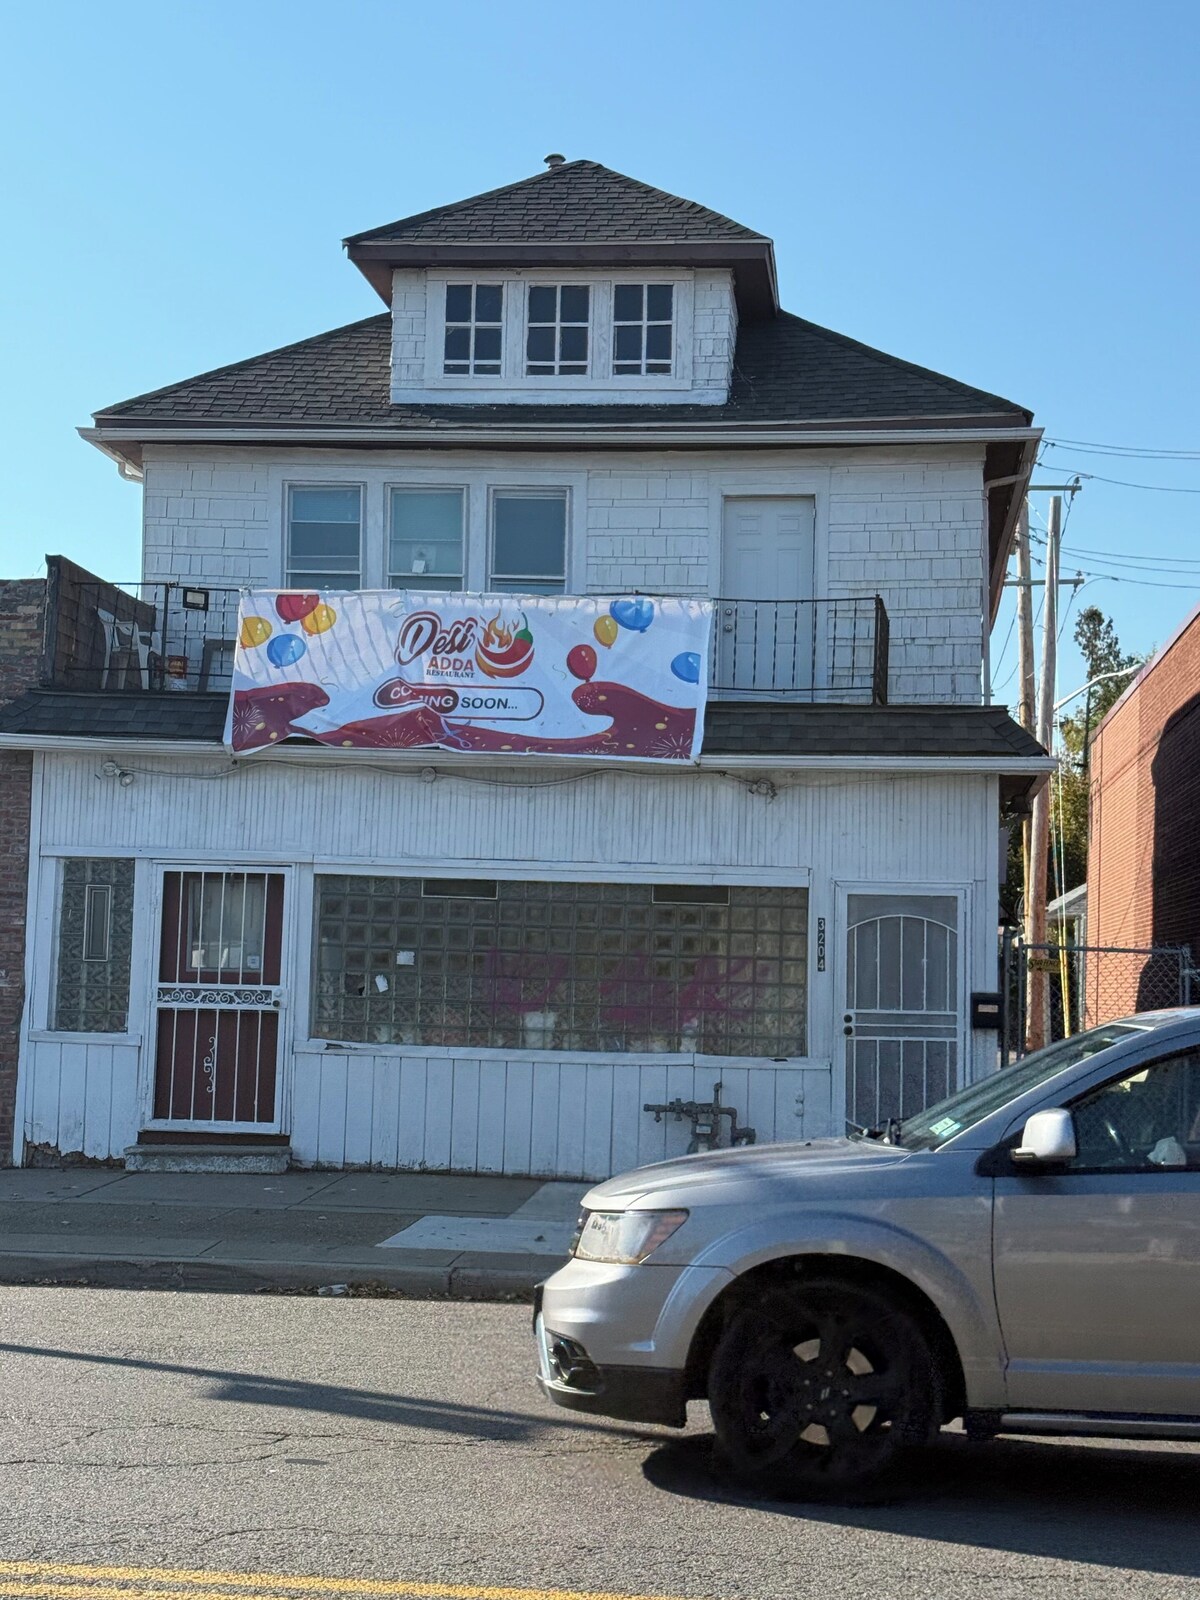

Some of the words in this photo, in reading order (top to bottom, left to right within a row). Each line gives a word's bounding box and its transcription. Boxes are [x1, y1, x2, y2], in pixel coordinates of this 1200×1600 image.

[396, 612, 477, 661] Desi
[428, 656, 474, 671] ADDA
[426, 669, 475, 678] RESTAURANT
[390, 685, 454, 707] COING
[460, 697, 518, 709] SOON...
